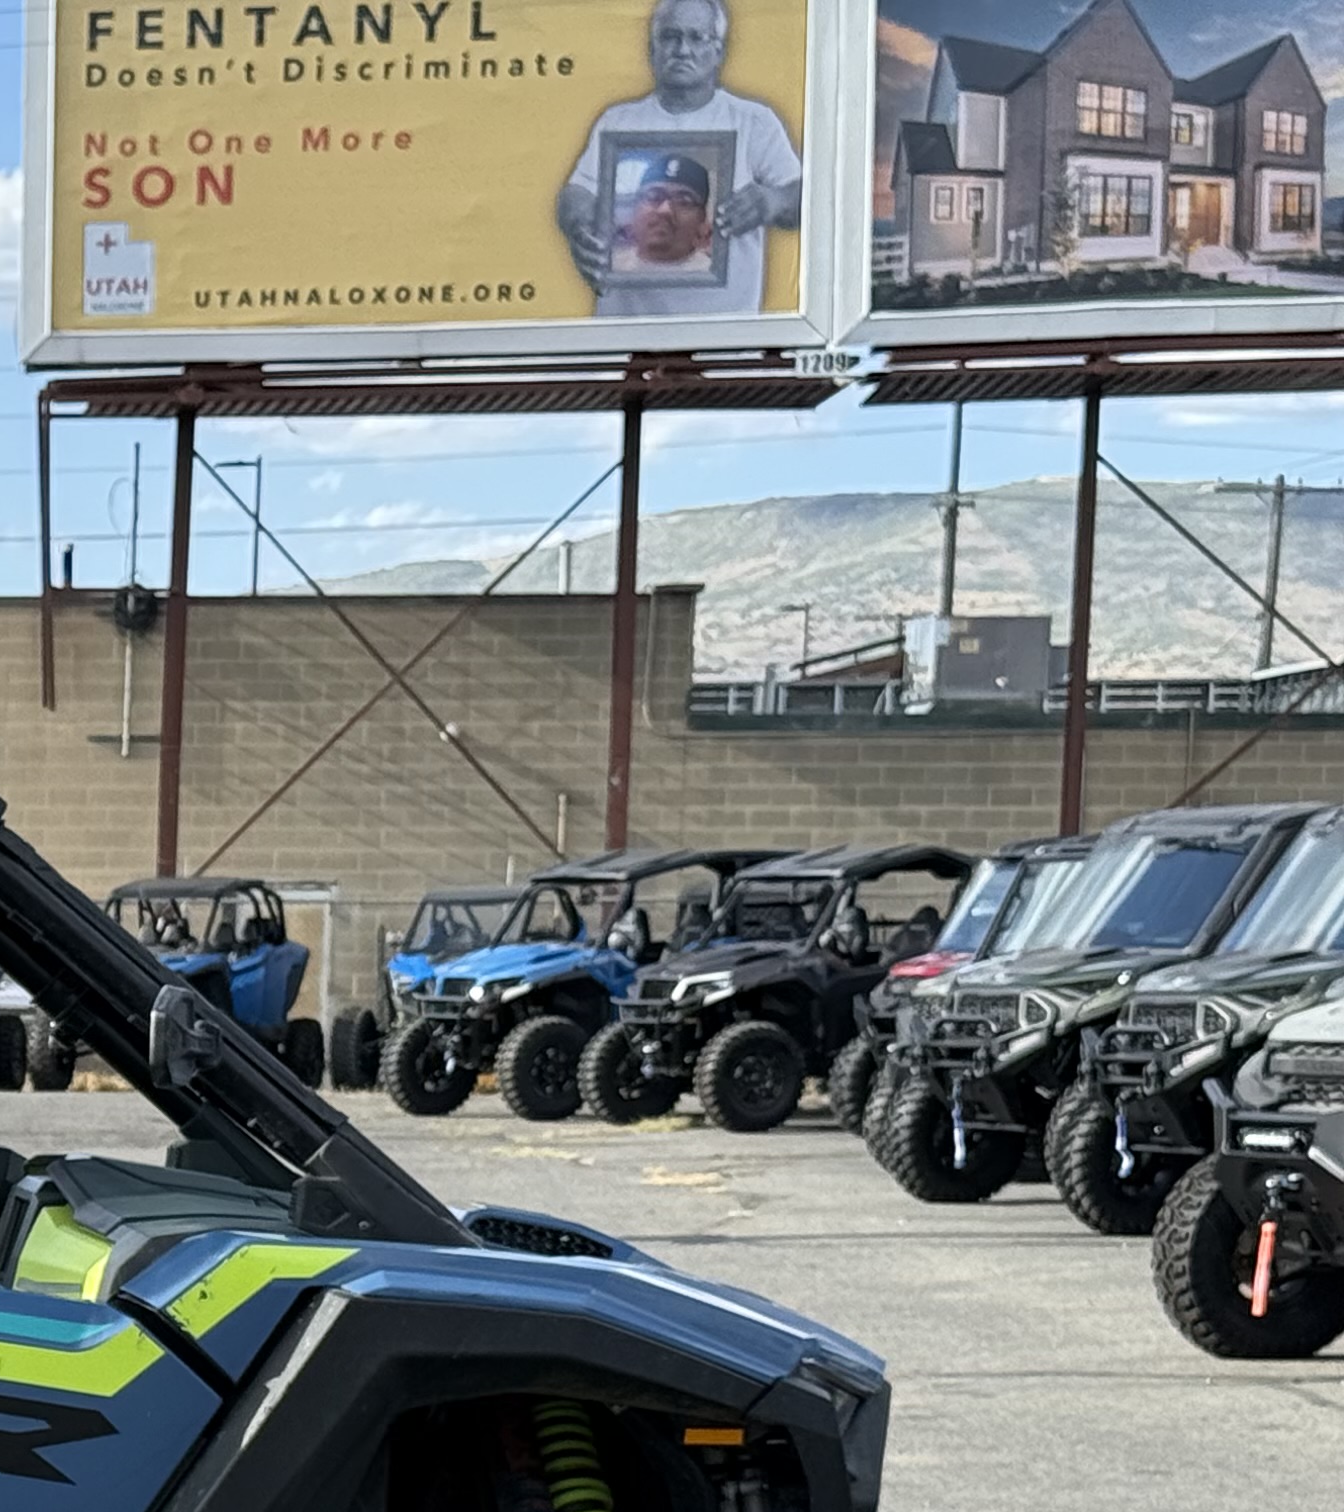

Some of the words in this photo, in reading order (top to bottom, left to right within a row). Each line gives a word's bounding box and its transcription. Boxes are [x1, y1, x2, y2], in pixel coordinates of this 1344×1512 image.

[86, 1, 497, 51] FENTANYL
[85, 58, 256, 88] Doesn't
[282, 52, 575, 84] Discriminate
[83, 132, 160, 158] Not
[187, 128, 272, 155] One
[300, 126, 414, 152] More
[82, 164, 235, 209] SON
[86, 276, 149, 296] UTAH
[193, 282, 537, 309] UTAHNALOXONE.ORG
